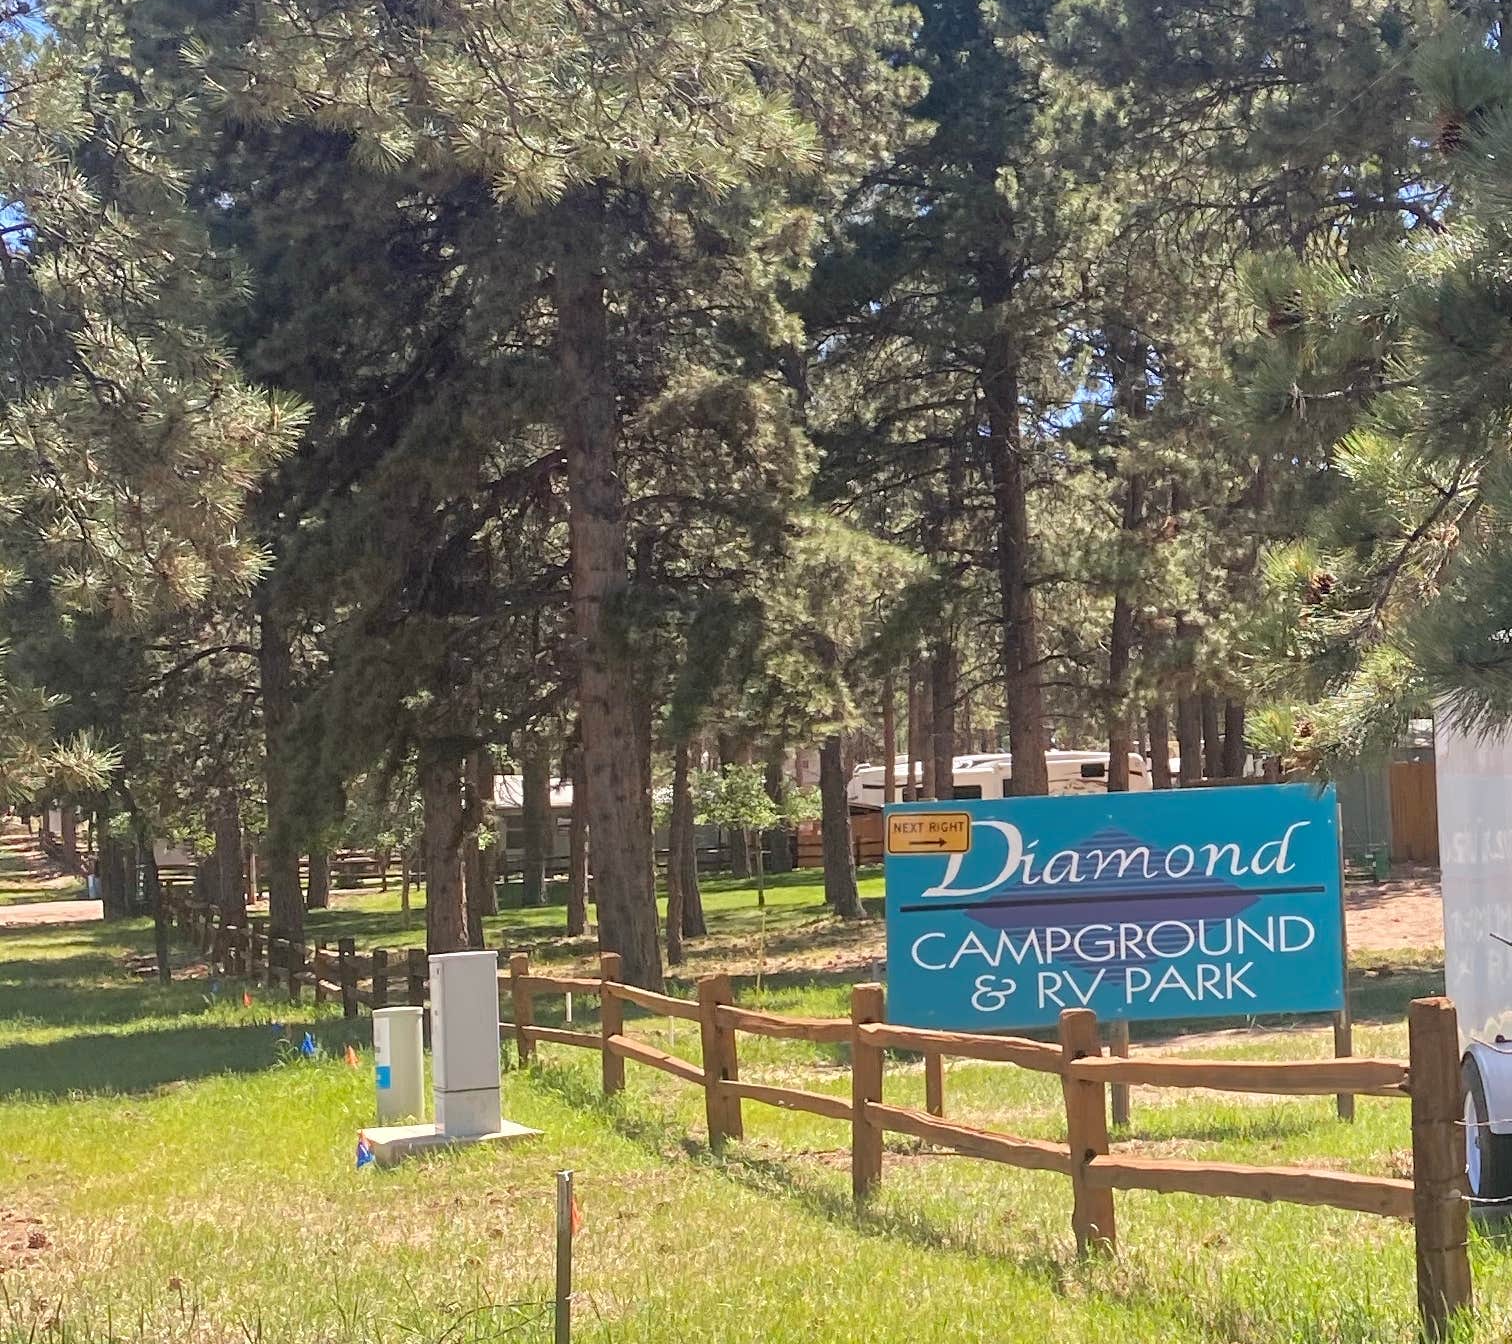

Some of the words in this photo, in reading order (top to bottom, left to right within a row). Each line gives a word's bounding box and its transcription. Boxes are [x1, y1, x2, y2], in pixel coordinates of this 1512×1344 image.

[893, 822, 924, 834] NEXT
[929, 821, 965, 833] RIGHT
[920, 819, 1312, 899] Diamond
[910, 914, 1316, 971] CAMPGROUND
[970, 974, 1017, 1013] &
[1038, 967, 1106, 1010] RV
[1125, 960, 1257, 1005] PARK
